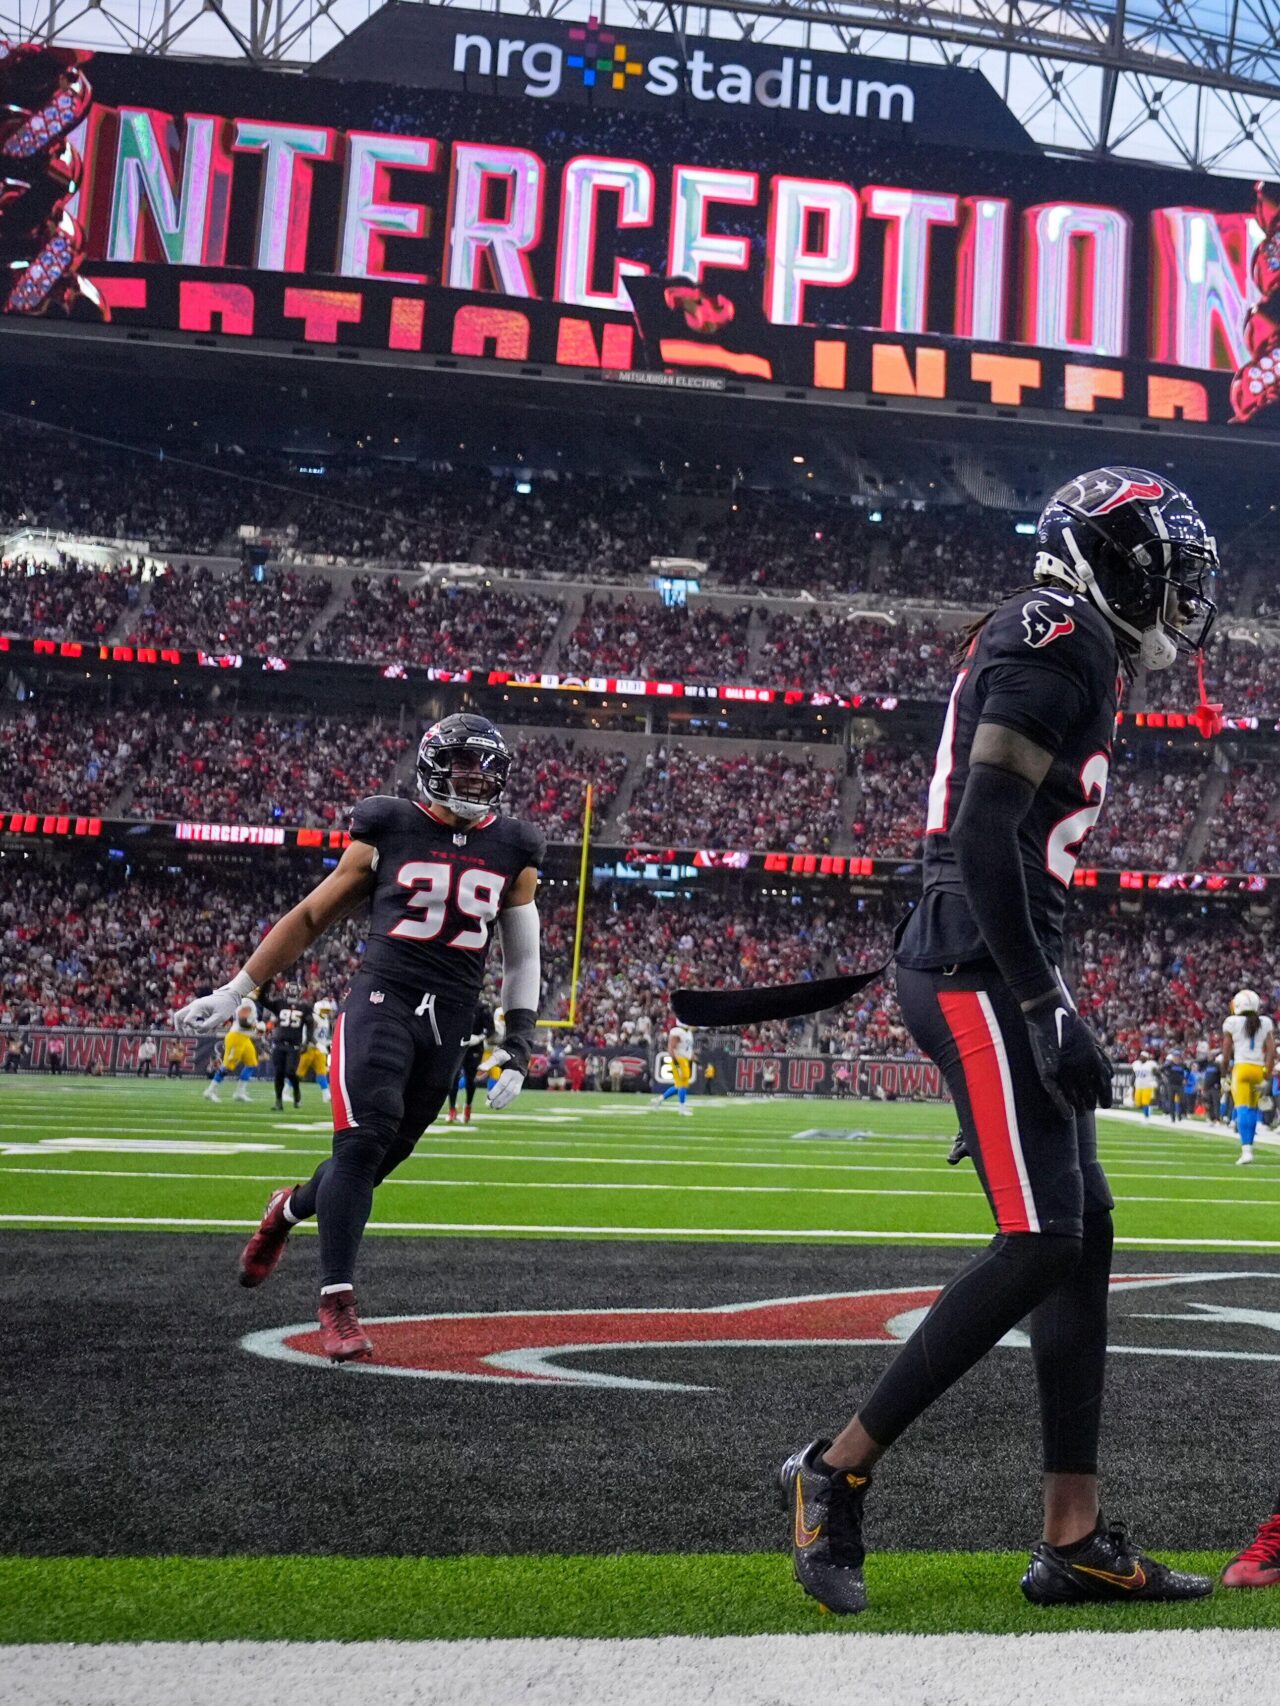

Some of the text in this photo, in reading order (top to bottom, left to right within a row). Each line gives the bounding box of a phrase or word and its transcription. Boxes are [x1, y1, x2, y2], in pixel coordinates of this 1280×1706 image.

[453, 33, 915, 124] nrg stadium
[618, 371, 723, 390] MITSUBISHI ELECTRIC
[175, 822, 285, 846] INTERCEPTION
[387, 861, 509, 951] 39
[279, 1008, 304, 1029] 95
[787, 1059, 825, 1092] UP
